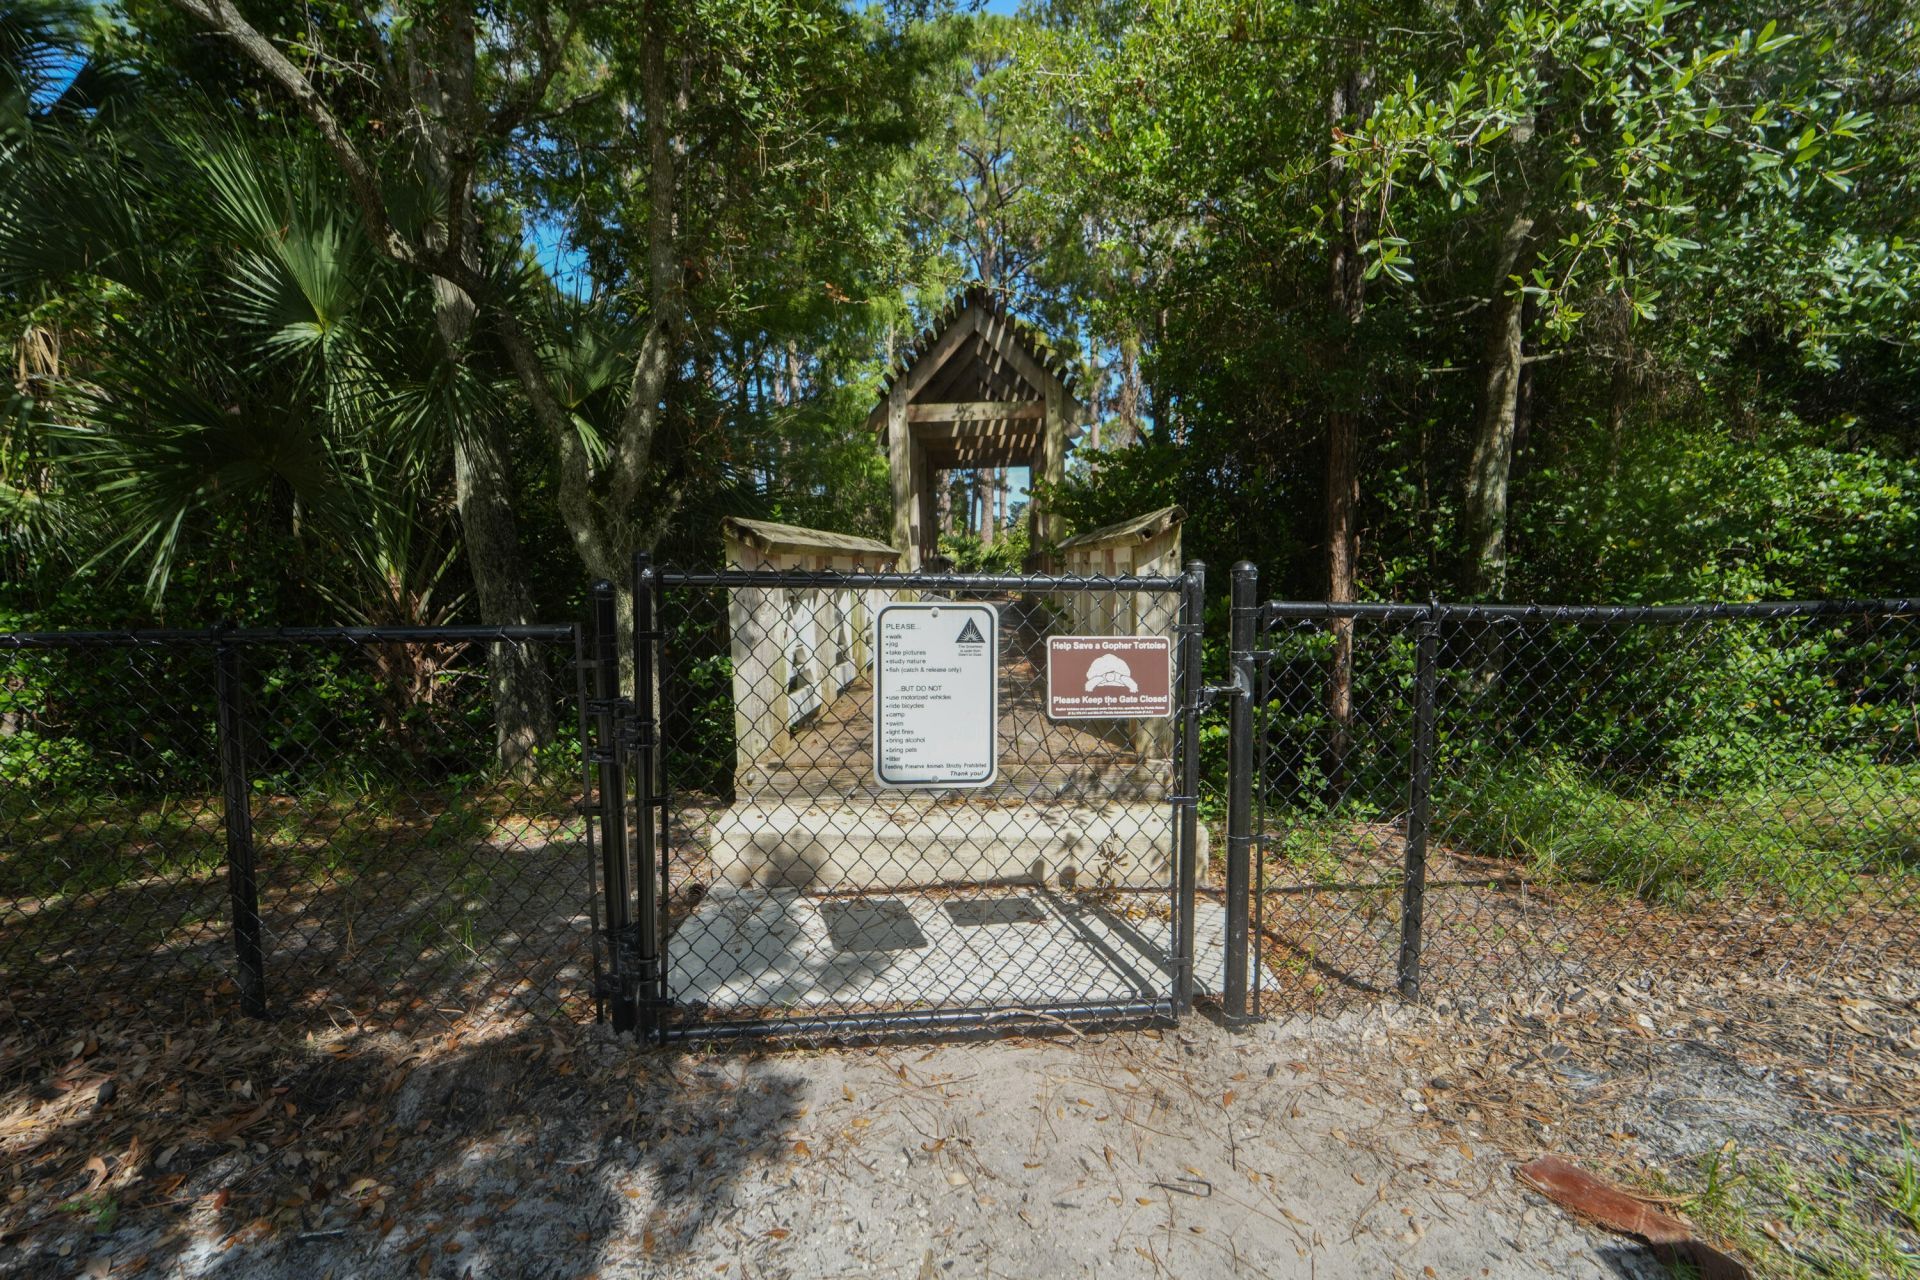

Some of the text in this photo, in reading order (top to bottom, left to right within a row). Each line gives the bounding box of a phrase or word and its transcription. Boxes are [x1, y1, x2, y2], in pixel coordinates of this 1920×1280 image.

[1052, 641, 1071, 651] Help
[1073, 641, 1094, 650] Save
[1101, 641, 1132, 651] Gopher
[1134, 641, 1167, 650] Tortoise
[1053, 695, 1168, 706] Please Keep the Gate Closed
